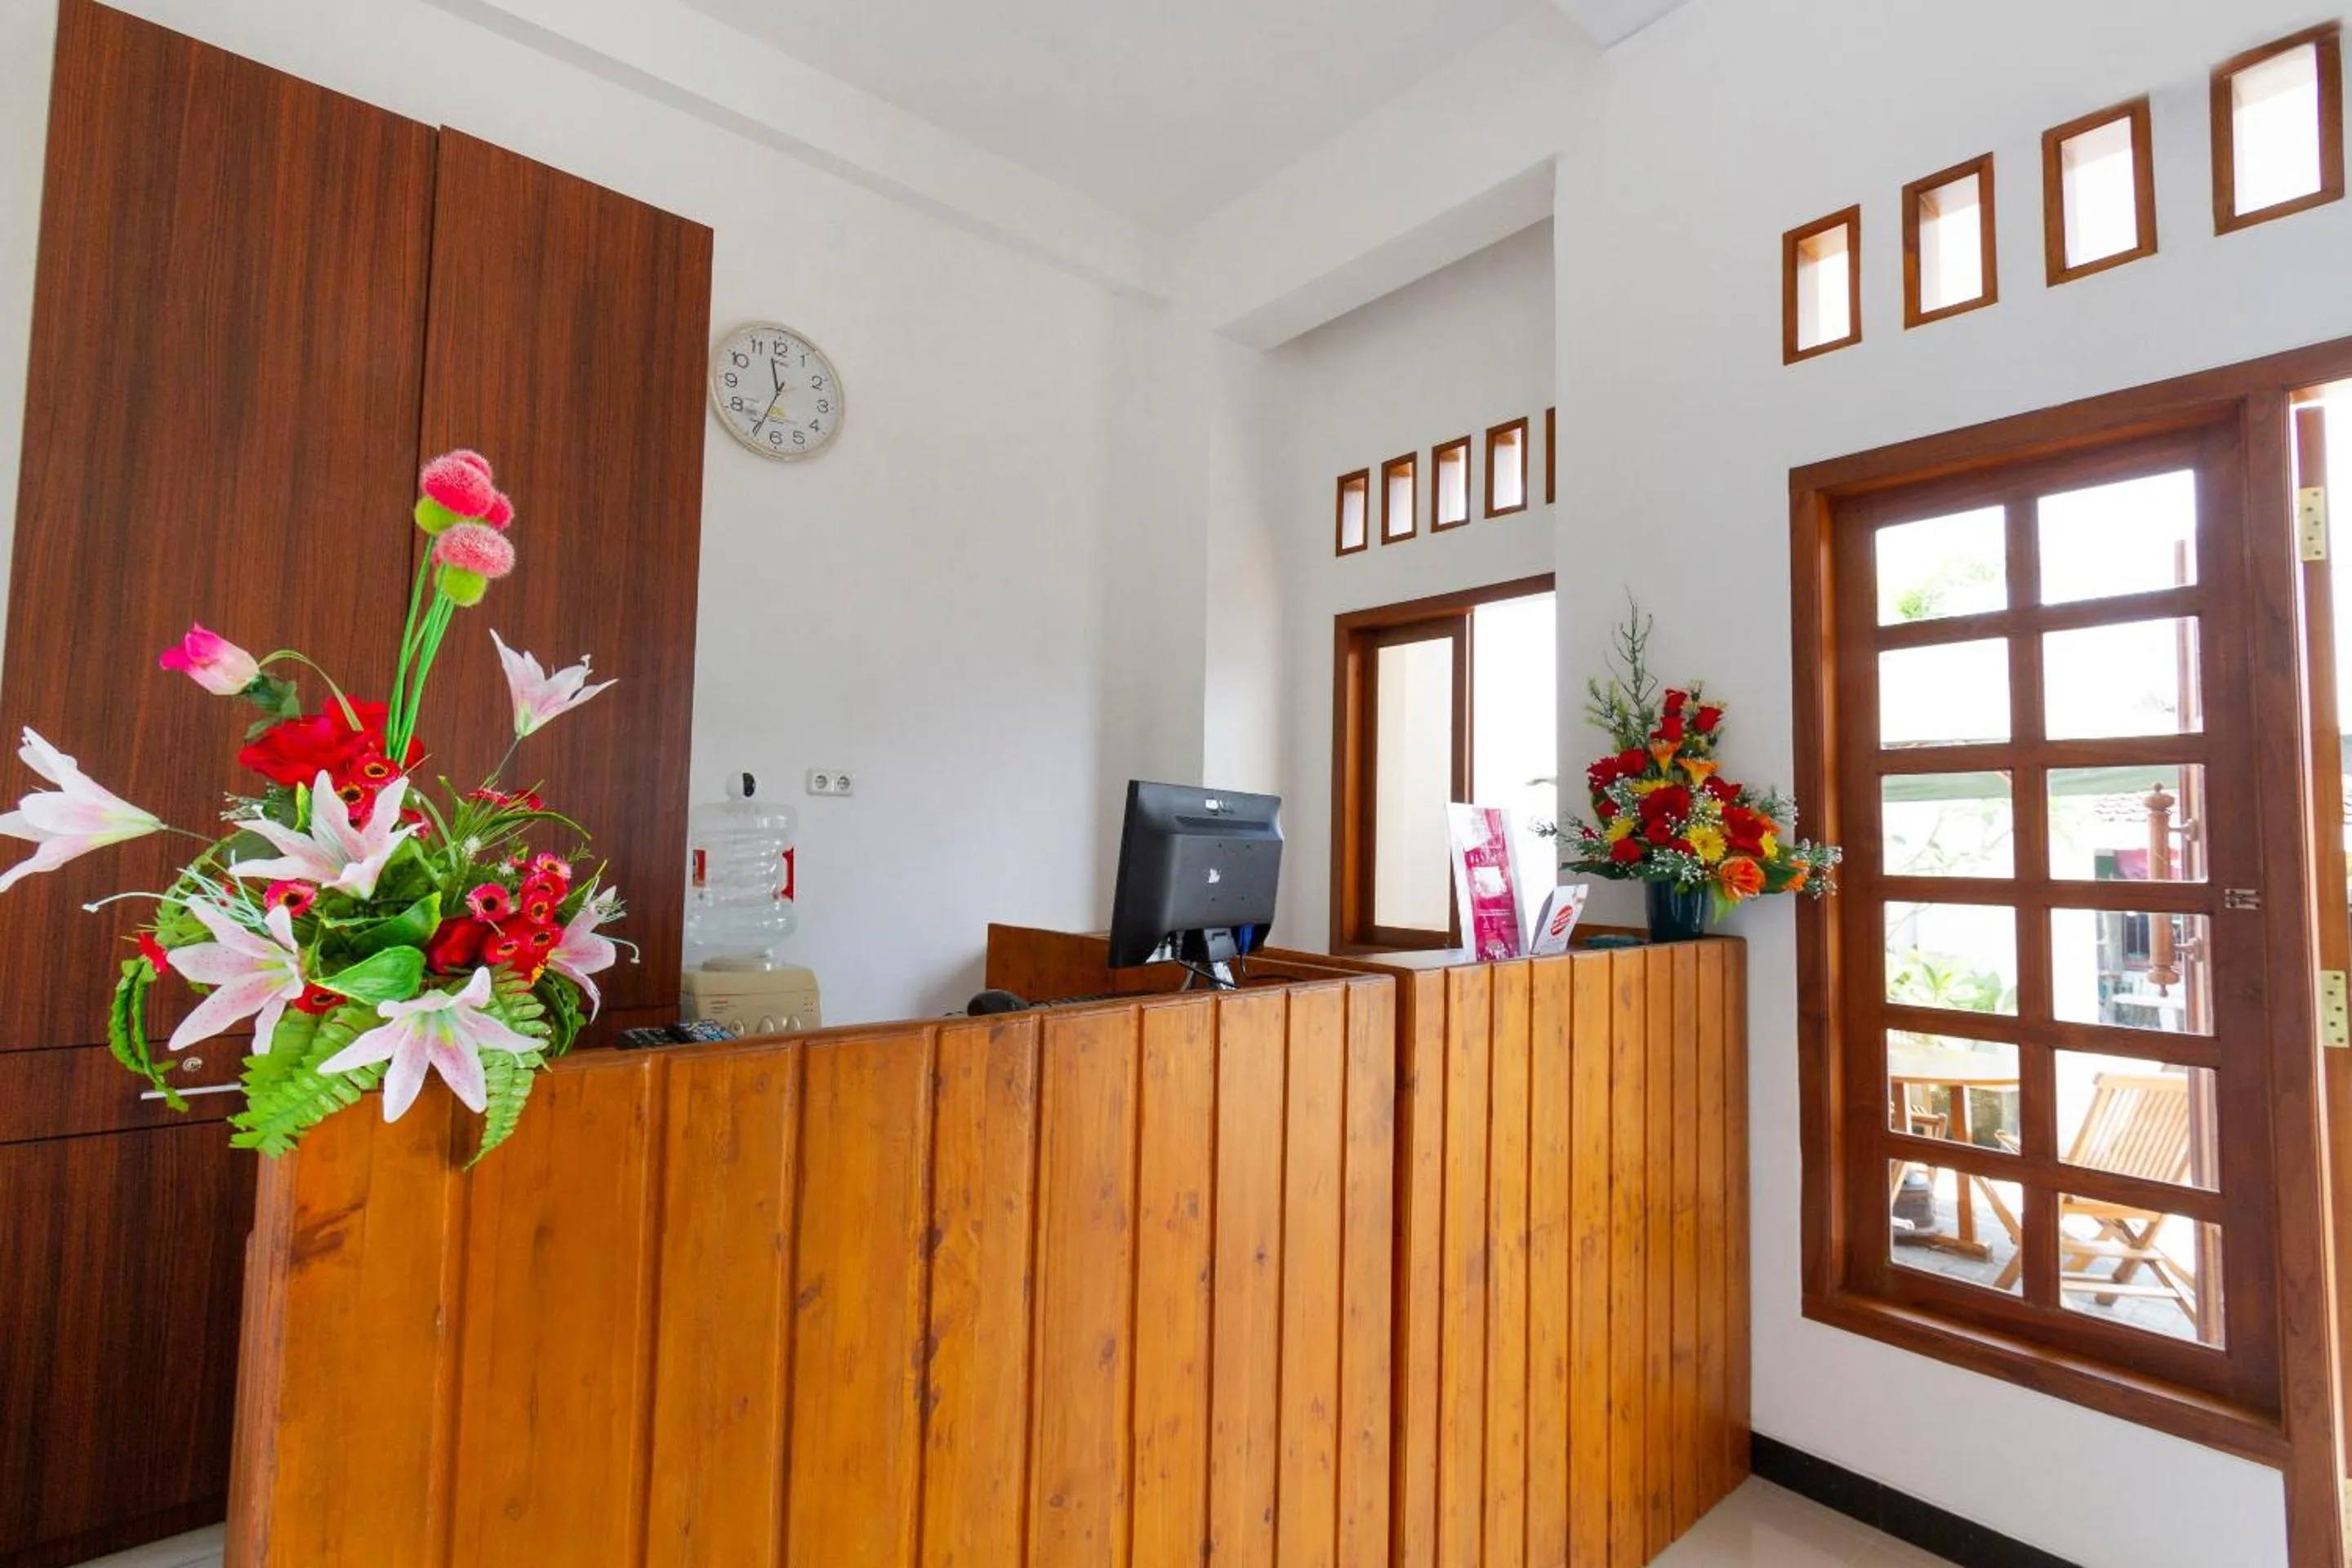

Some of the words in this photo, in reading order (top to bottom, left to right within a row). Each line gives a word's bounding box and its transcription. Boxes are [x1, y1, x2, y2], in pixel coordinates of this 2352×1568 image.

[751, 340, 763, 354] 11
[773, 340, 788, 358] 12
[732, 352, 749, 368] 10
[800, 355, 806, 368] 1
[724, 372, 737, 388] 9
[811, 375, 823, 390] 2
[730, 396, 743, 412] 8
[816, 399, 829, 413] 3
[809, 419, 820, 432] 4
[769, 430, 783, 445] 6
[792, 430, 805, 444] 5
